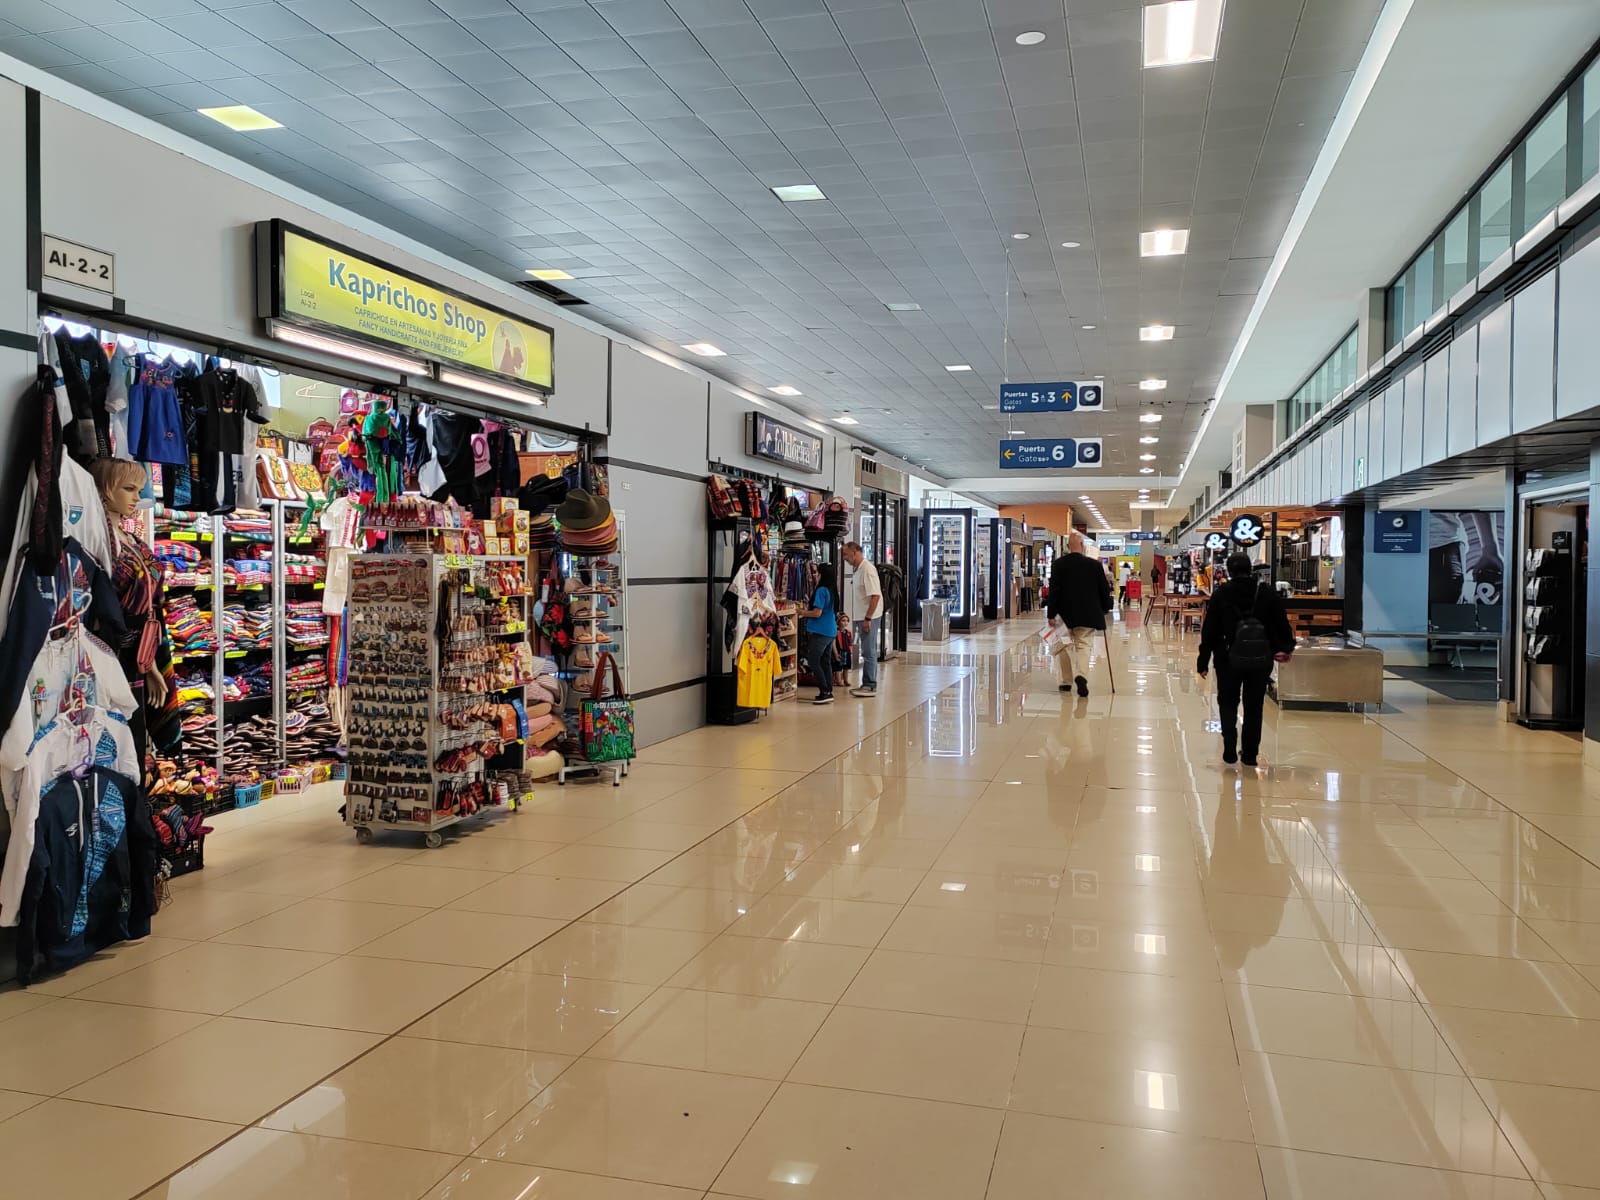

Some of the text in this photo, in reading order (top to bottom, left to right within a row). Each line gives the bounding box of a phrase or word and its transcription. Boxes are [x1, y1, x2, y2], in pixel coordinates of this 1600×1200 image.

[49, 250, 109, 279] AI-2-2
[329, 258, 487, 342] Kaprichos Shop
[354, 306, 389, 324] CAPRICHOS
[390, 318, 398, 326] EN
[359, 319, 379, 331] FANCY
[379, 325, 418, 344] HANDICRAFTS
[418, 338, 430, 347] AND
[1031, 392, 1040, 403] 5
[1047, 391, 1056, 403] 3
[1052, 445, 1065, 461] 6
